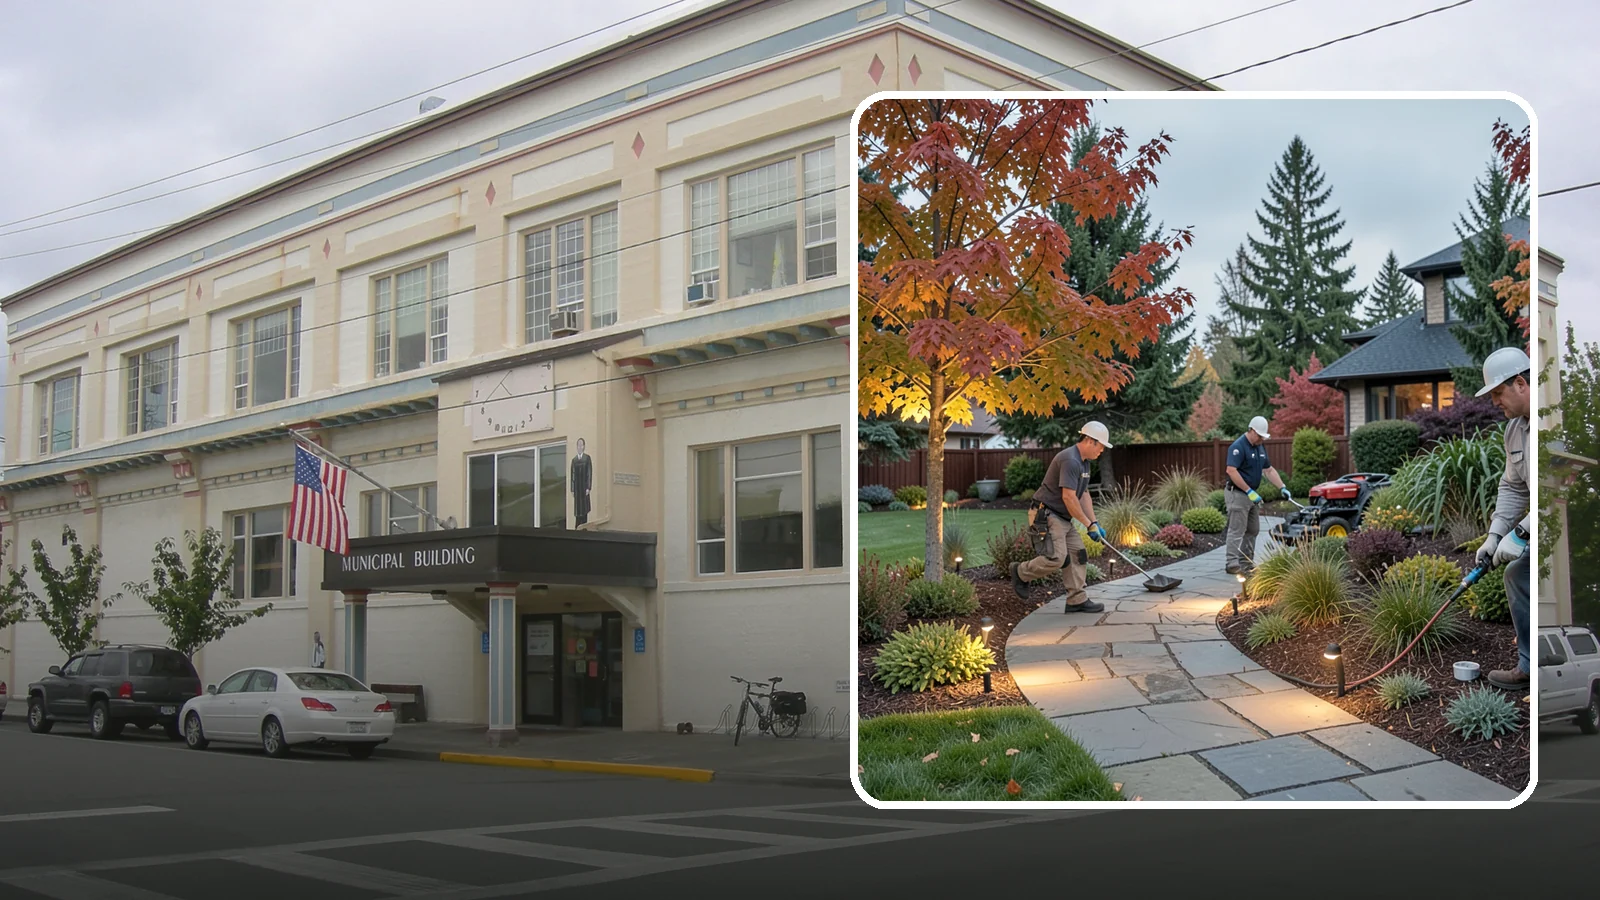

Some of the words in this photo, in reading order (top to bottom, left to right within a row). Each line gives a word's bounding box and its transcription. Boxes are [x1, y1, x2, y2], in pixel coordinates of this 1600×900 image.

[495, 424, 500, 432] 10
[507, 425, 513, 433] 12
[342, 552, 405, 572] MUNICIPAL
[414, 546, 475, 567] BUILDING
